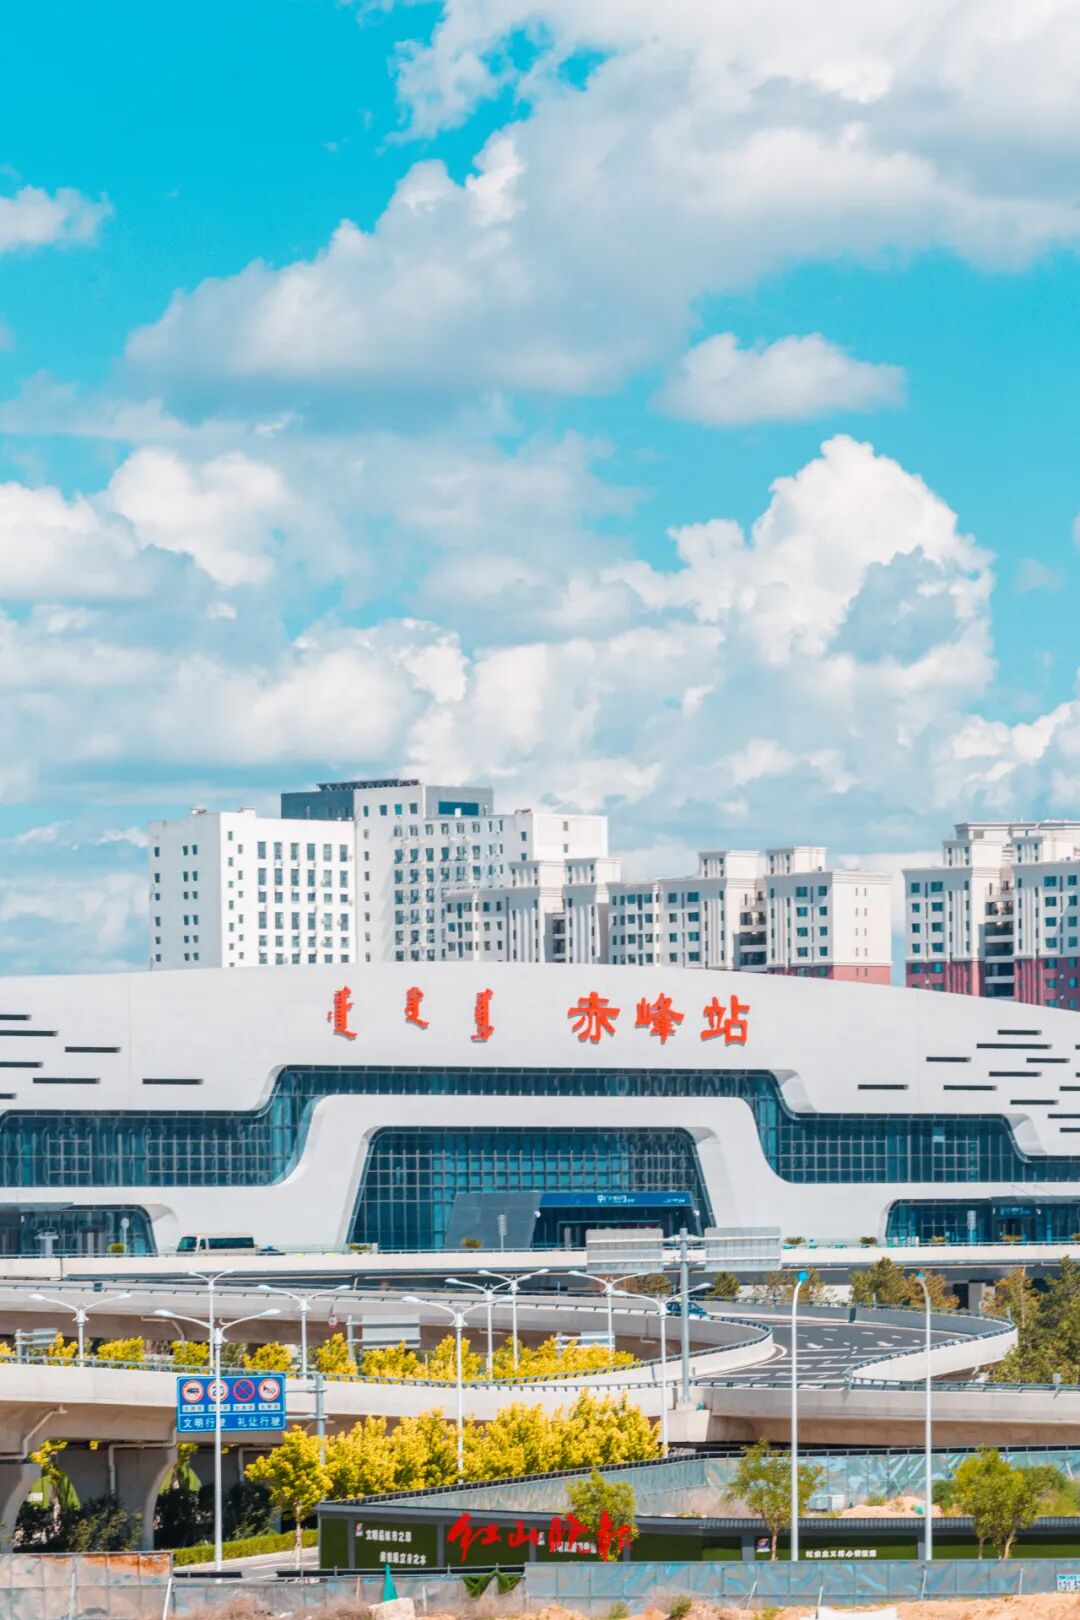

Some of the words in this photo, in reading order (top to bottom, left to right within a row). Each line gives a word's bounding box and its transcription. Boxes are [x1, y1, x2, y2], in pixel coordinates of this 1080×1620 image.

[568, 992, 750, 1043] 赤峰站
[806, 1550, 876, 1558] 社会主义核心价值观
